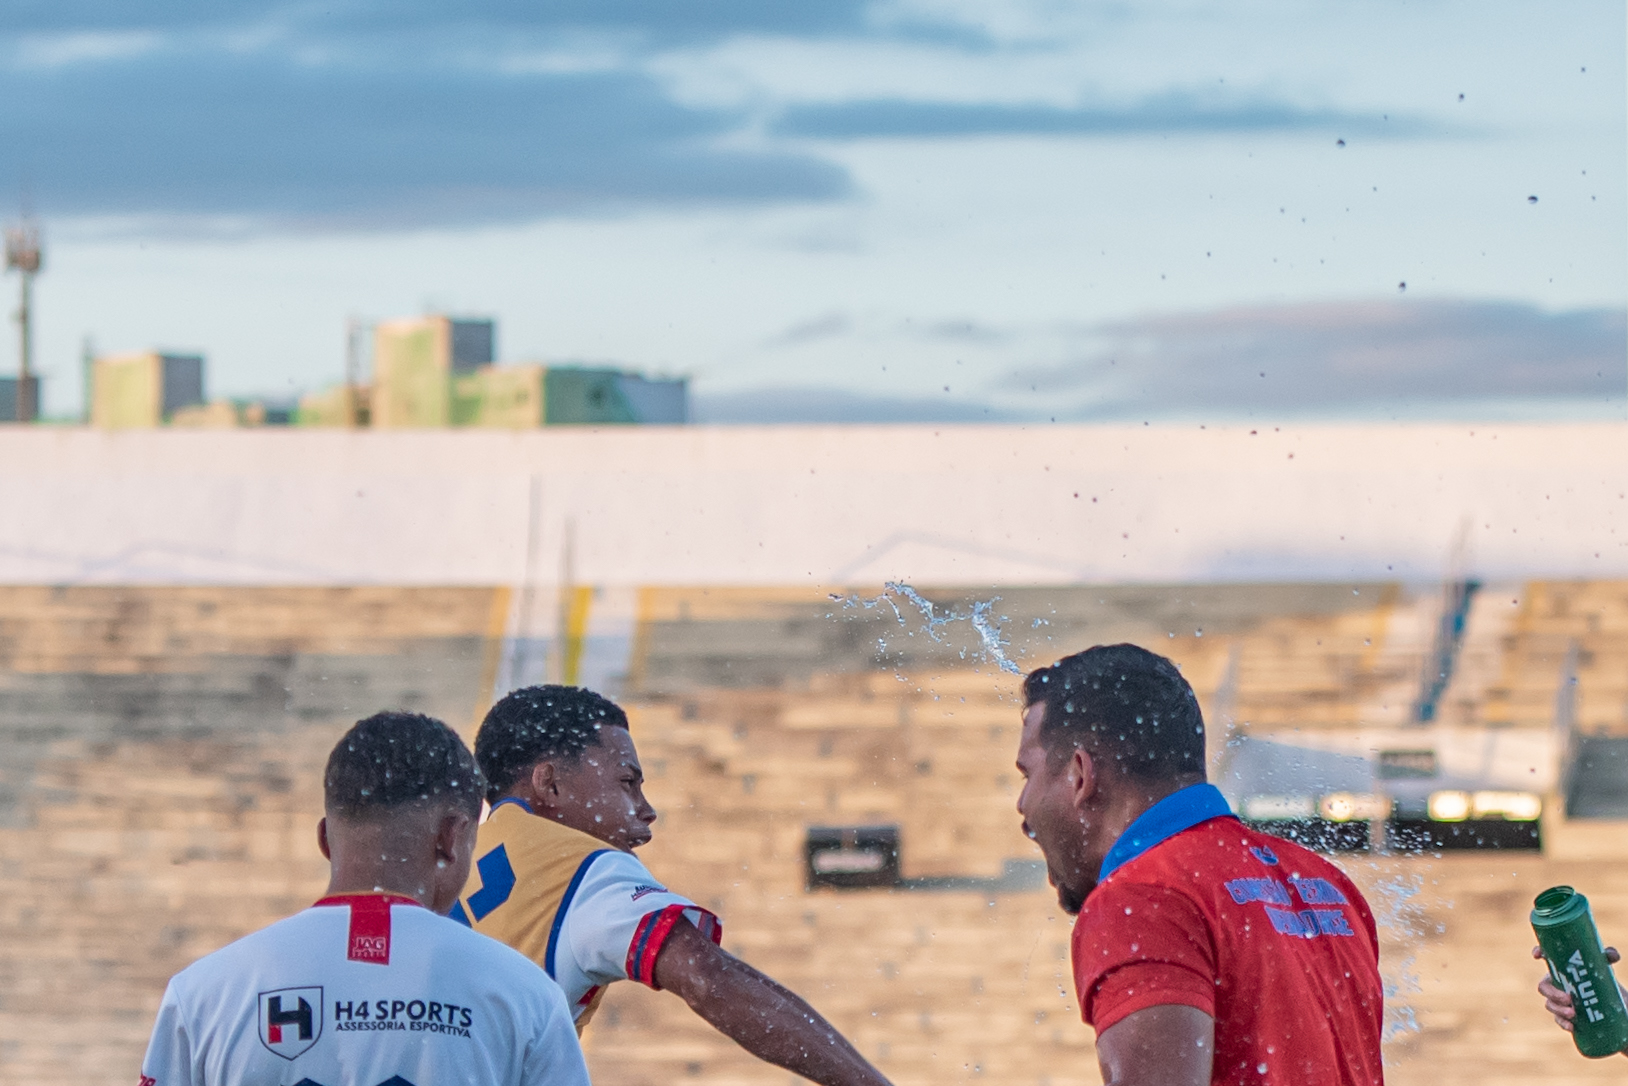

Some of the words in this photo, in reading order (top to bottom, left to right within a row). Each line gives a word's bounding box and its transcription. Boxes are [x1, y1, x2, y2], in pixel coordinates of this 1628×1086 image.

[335, 1001, 370, 1021] H4
[375, 999, 473, 1028] SPORTS
[335, 1020, 406, 1032] ASSESSORIA
[409, 1021, 472, 1039] ESPORTIVA
